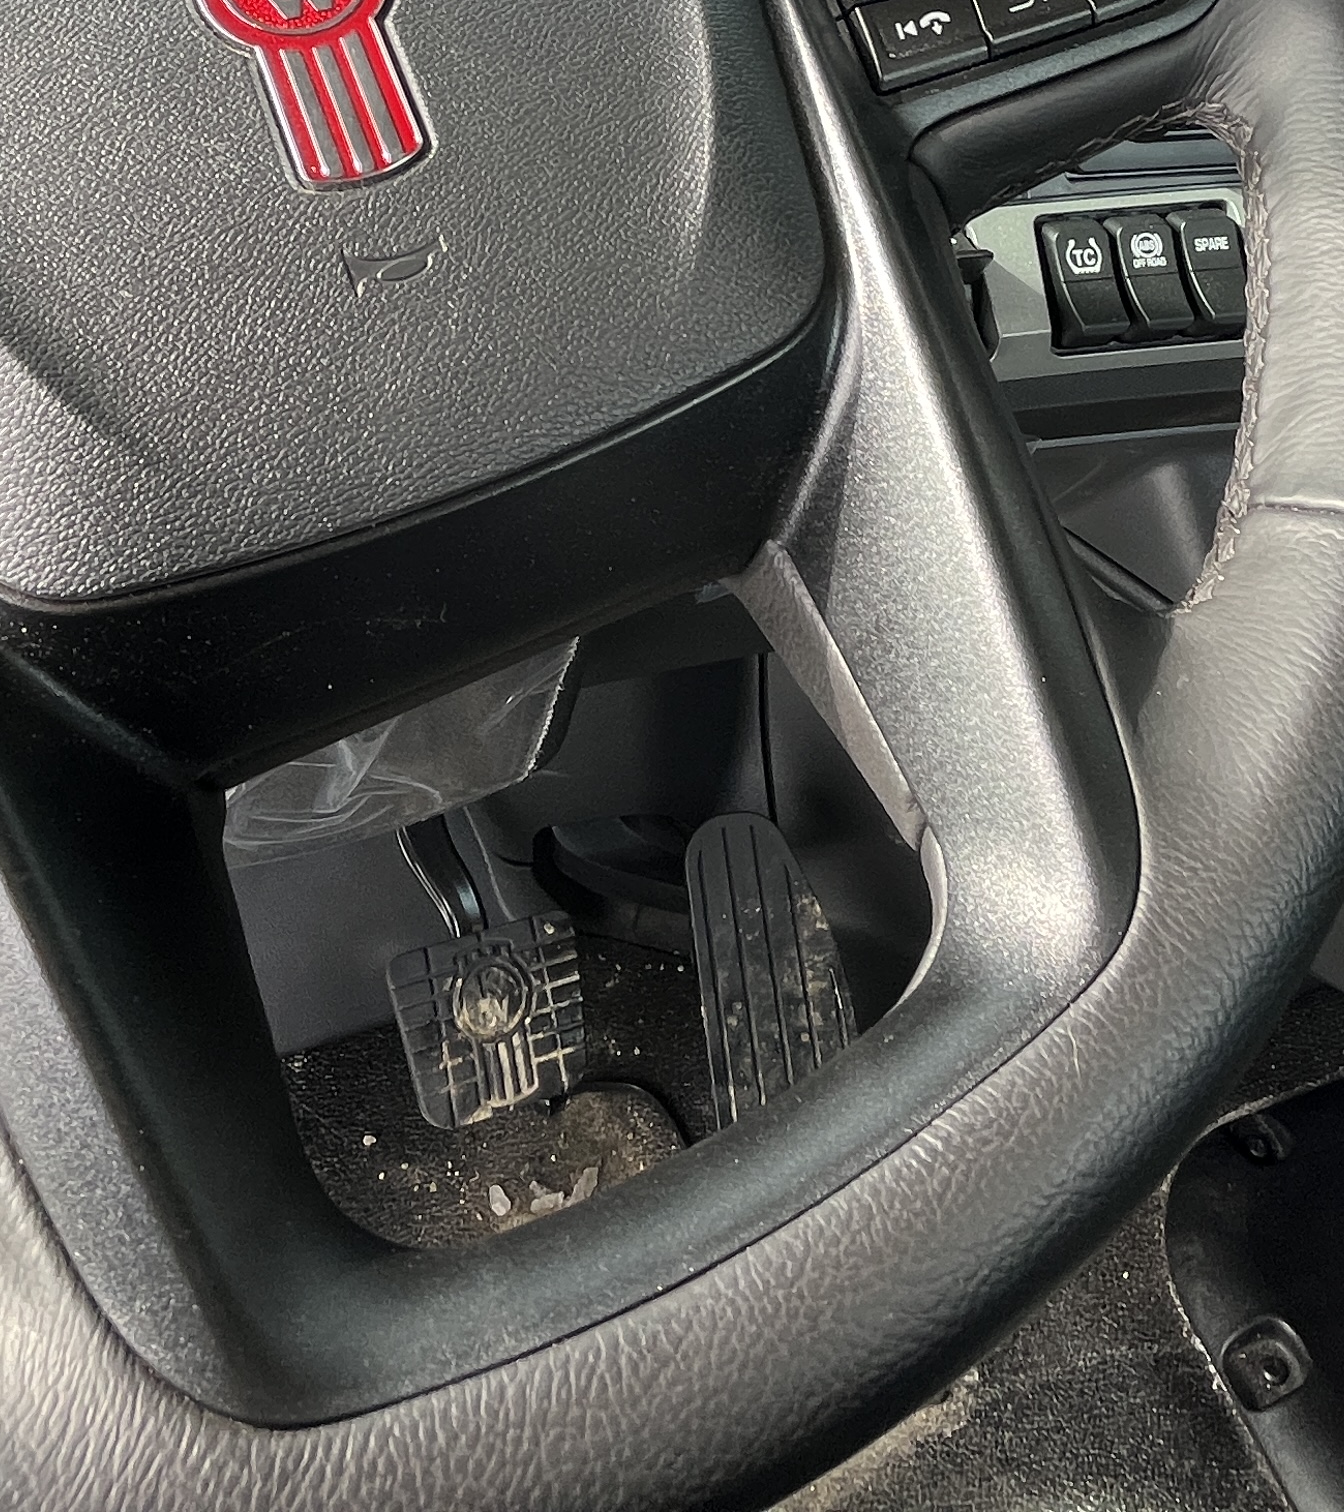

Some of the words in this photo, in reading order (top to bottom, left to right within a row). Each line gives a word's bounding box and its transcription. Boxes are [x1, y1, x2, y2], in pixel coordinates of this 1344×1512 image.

[1194, 237, 1230, 252] SPARE
[1072, 249, 1096, 267] TC
[1132, 257, 1147, 270] OFF
[1147, 256, 1167, 268] ROAD
